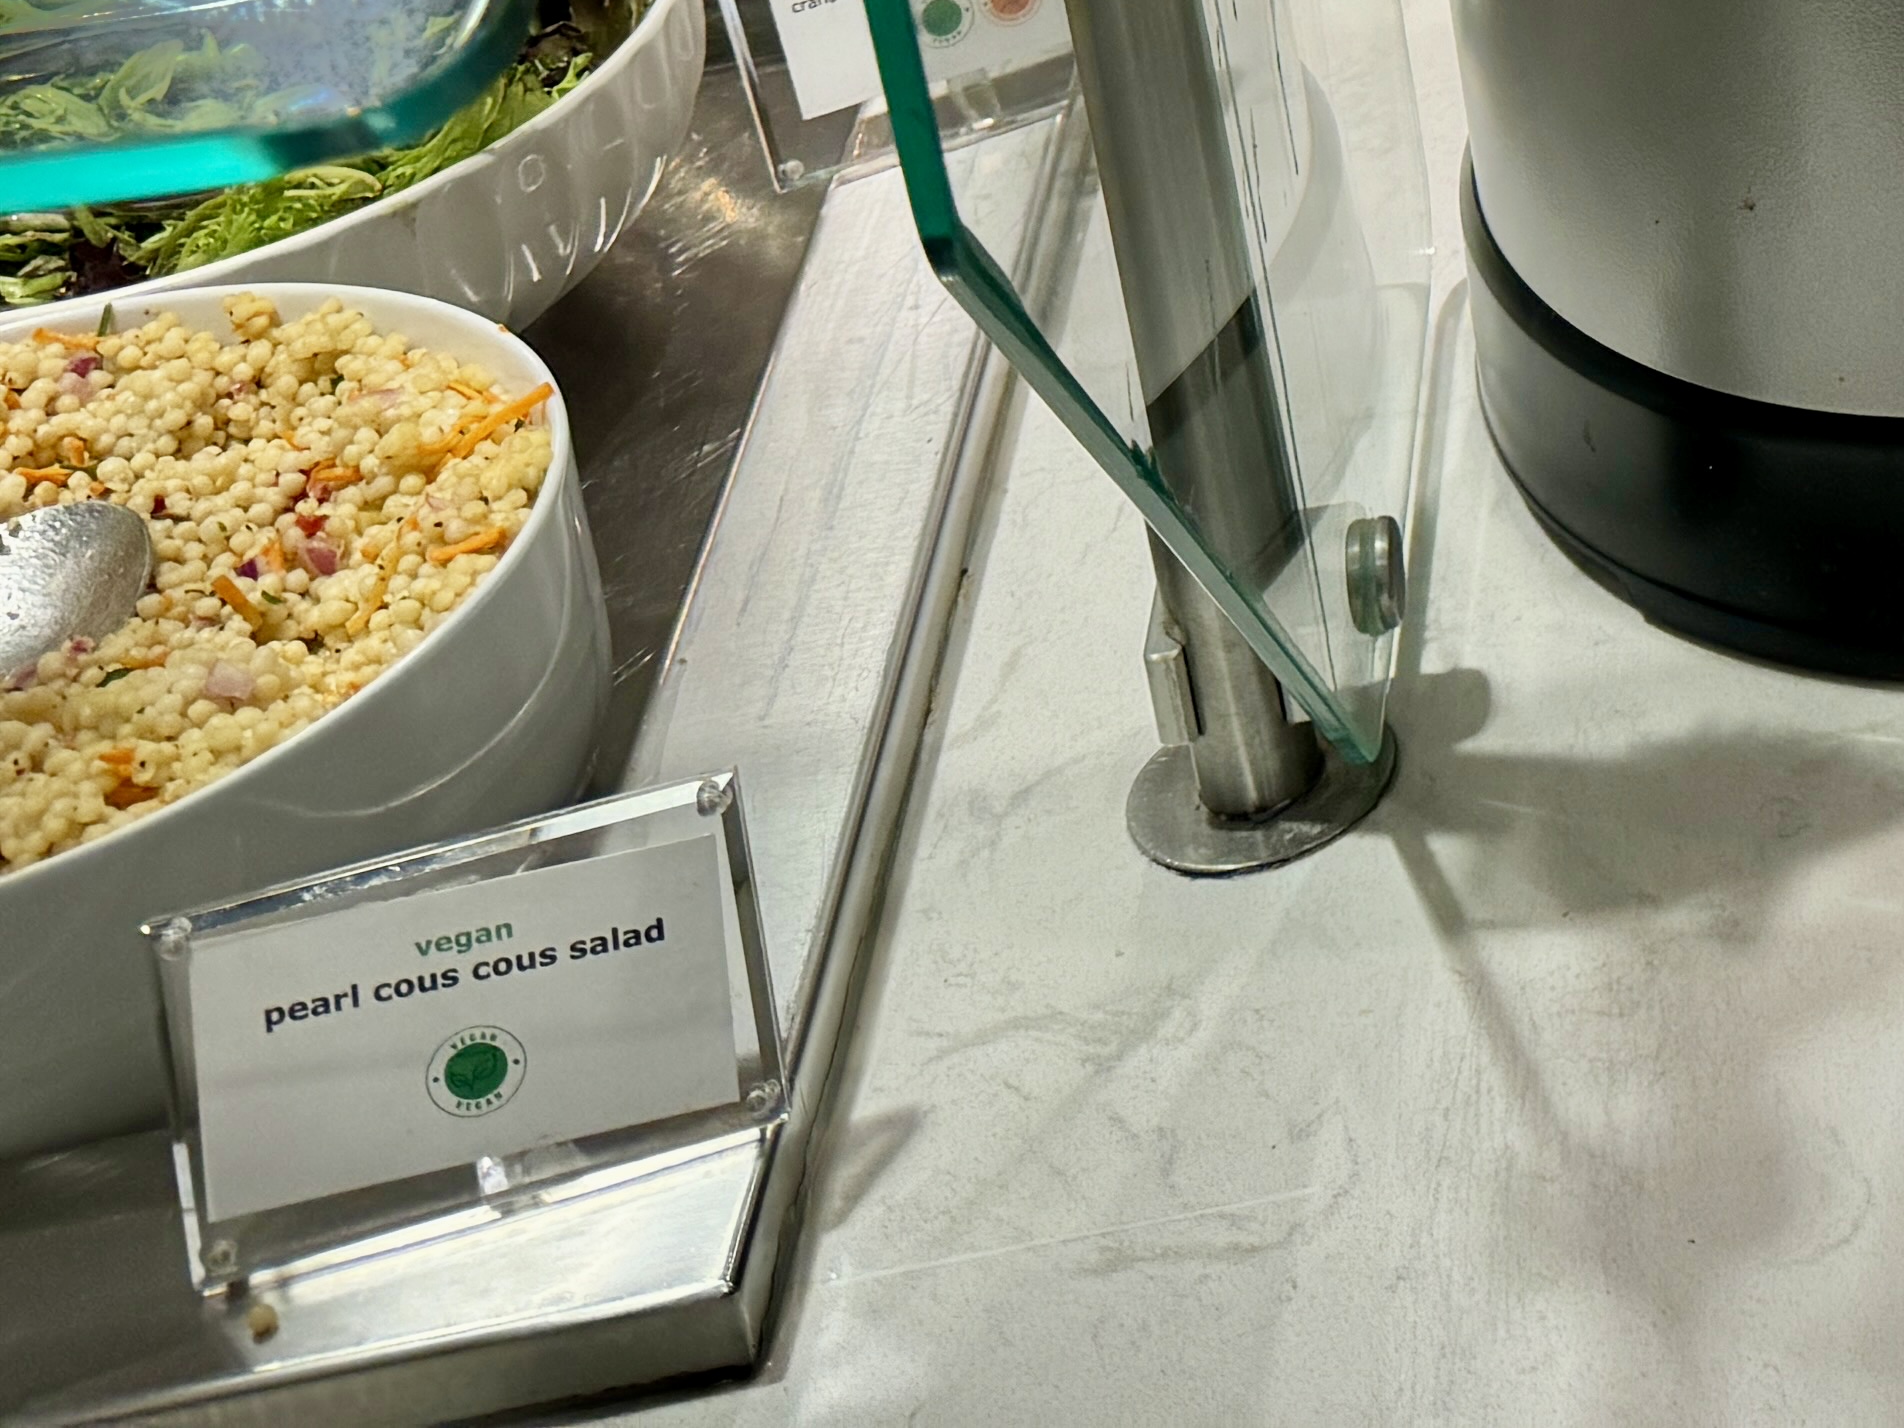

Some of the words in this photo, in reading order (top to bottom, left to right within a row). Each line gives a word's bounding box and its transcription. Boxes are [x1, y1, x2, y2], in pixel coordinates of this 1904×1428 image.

[263, 982, 361, 1033] pearl
[373, 966, 461, 1002] cous
[471, 946, 559, 983] cous
[568, 918, 667, 961] salad
[413, 918, 515, 958] vegan
